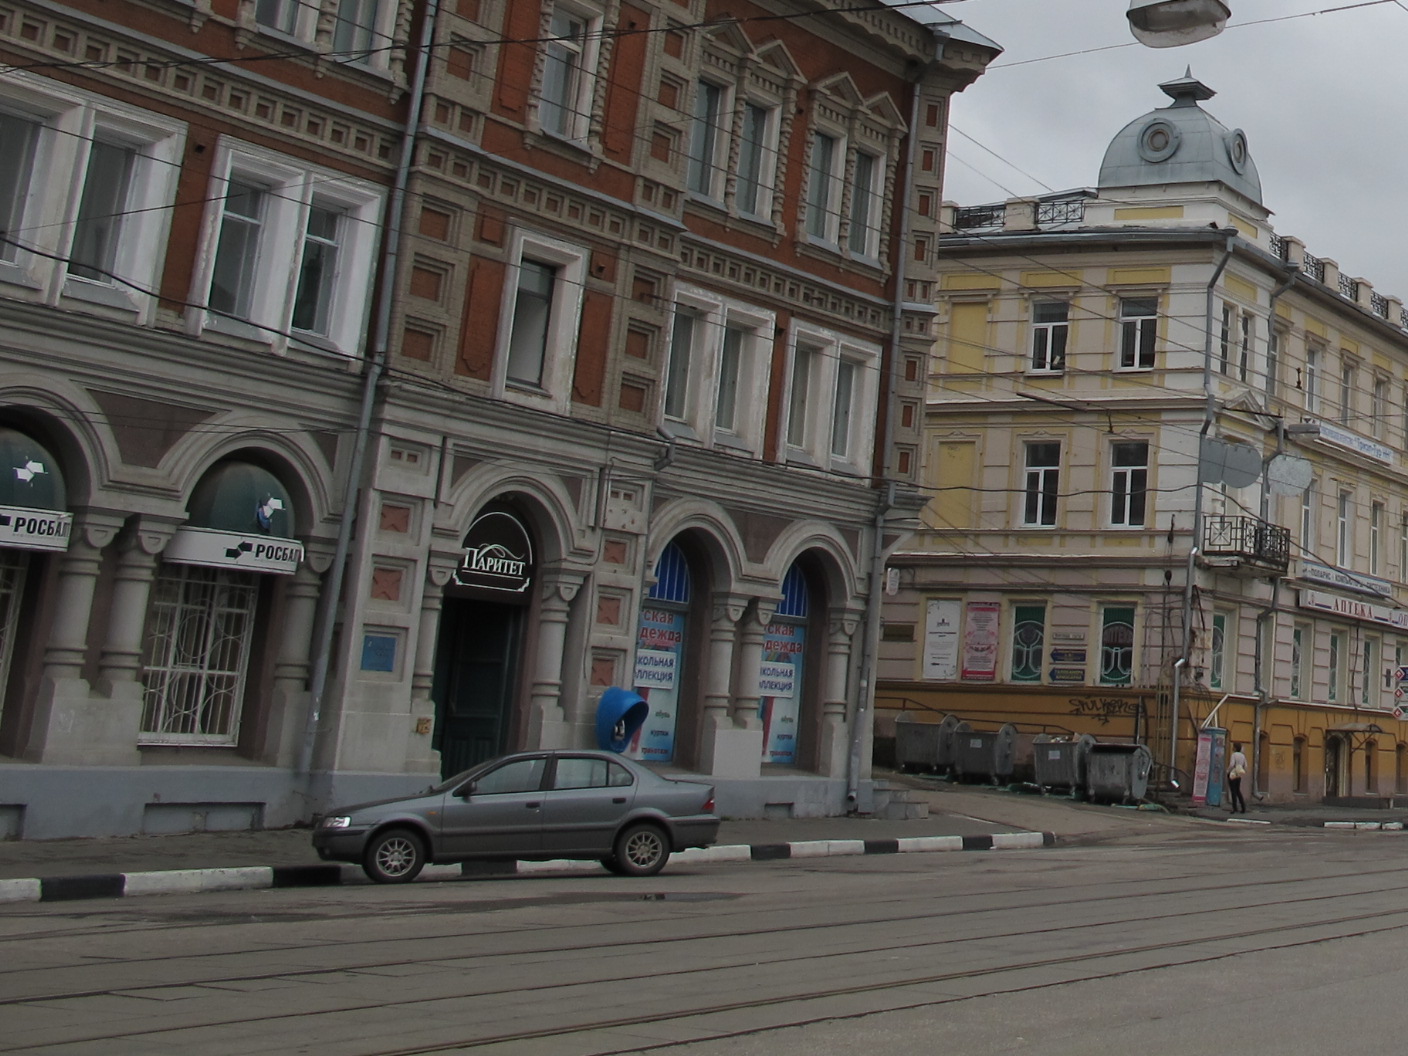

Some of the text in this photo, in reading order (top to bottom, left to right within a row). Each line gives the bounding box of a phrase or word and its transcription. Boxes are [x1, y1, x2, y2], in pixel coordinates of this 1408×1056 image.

[462, 546, 526, 576] ПАРИТЕТ
[642, 610, 674, 624] ская
[1334, 598, 1374, 619] АПТЕКА
